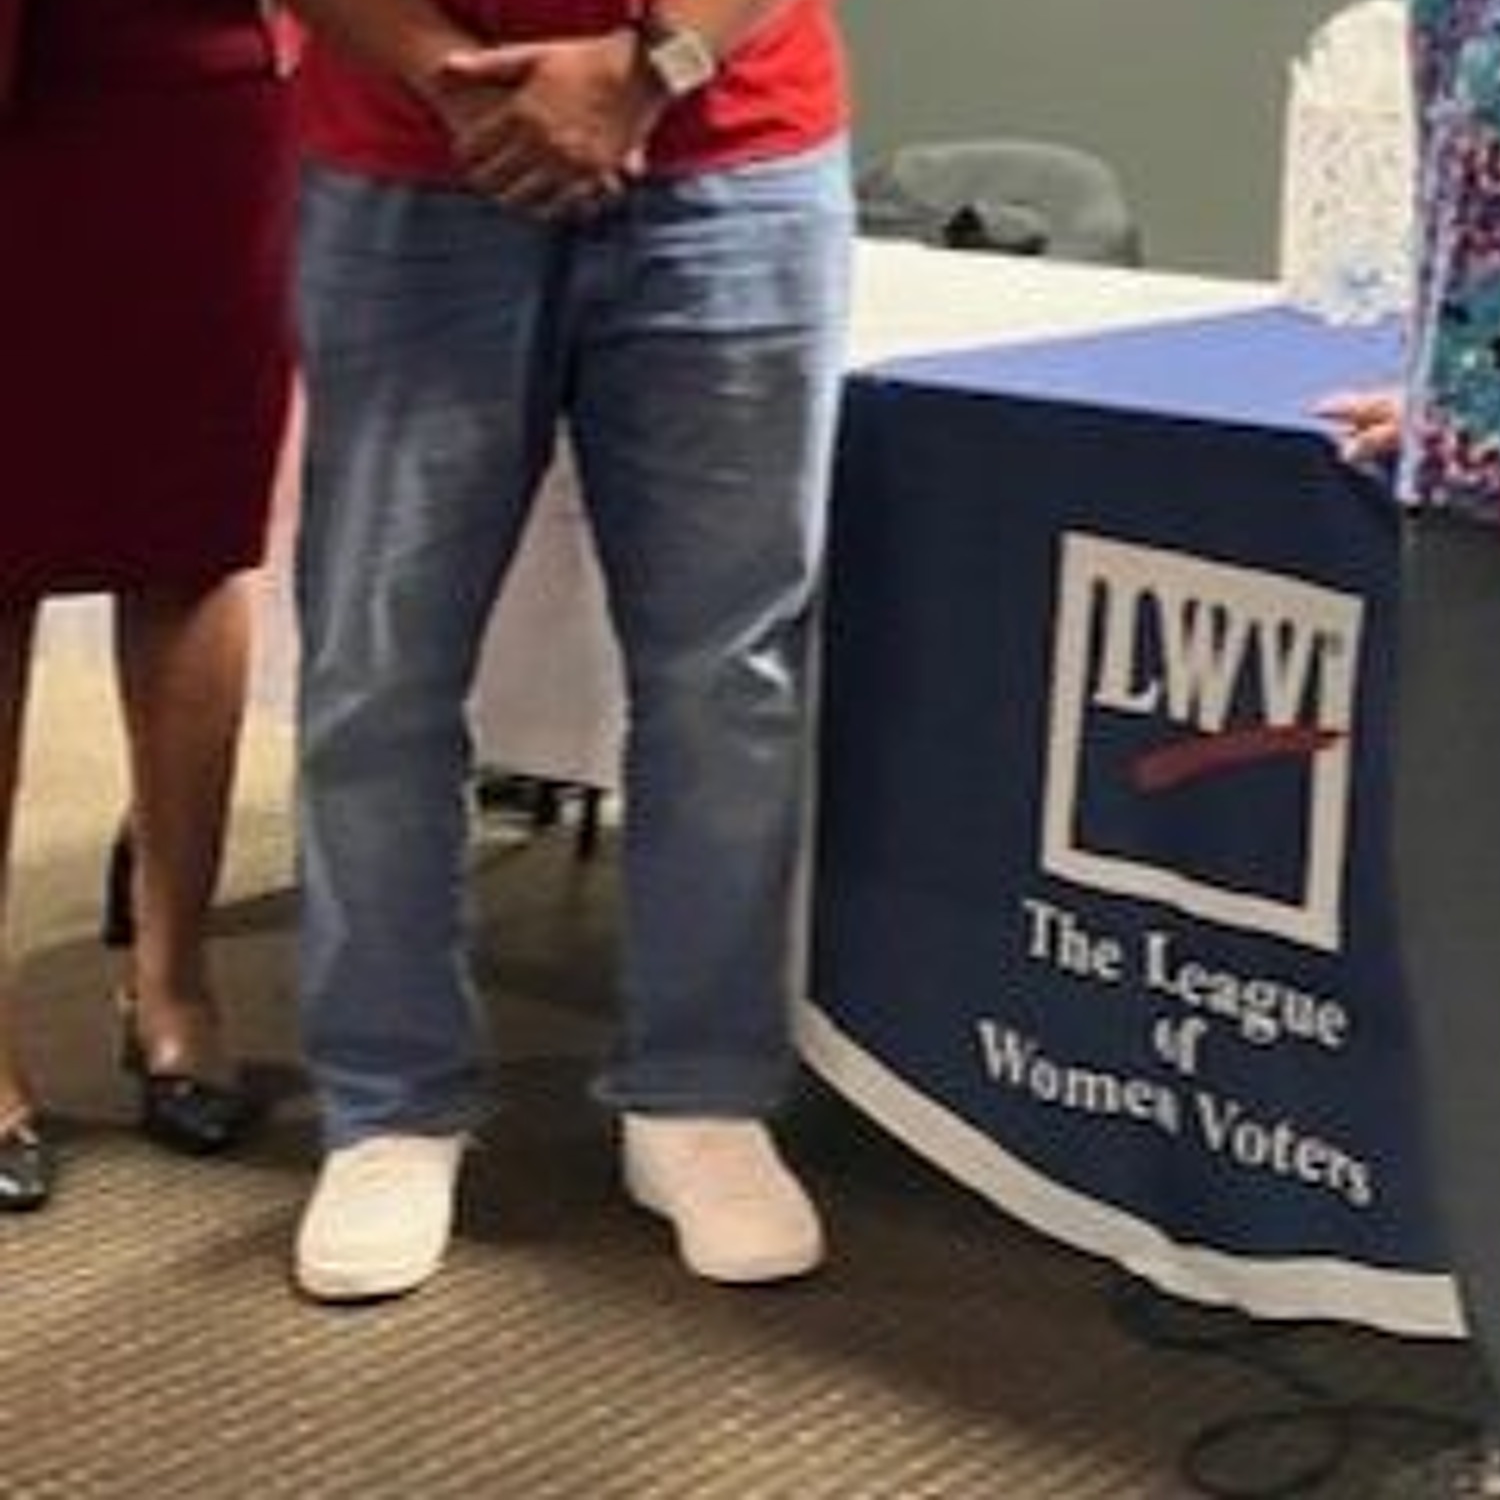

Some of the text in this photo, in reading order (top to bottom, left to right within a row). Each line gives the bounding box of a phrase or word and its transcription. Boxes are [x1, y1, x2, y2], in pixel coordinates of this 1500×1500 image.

[1022, 898, 1350, 1048] The League
[1153, 1016, 1209, 1074] of
[1195, 1091, 1374, 1208] Voters
